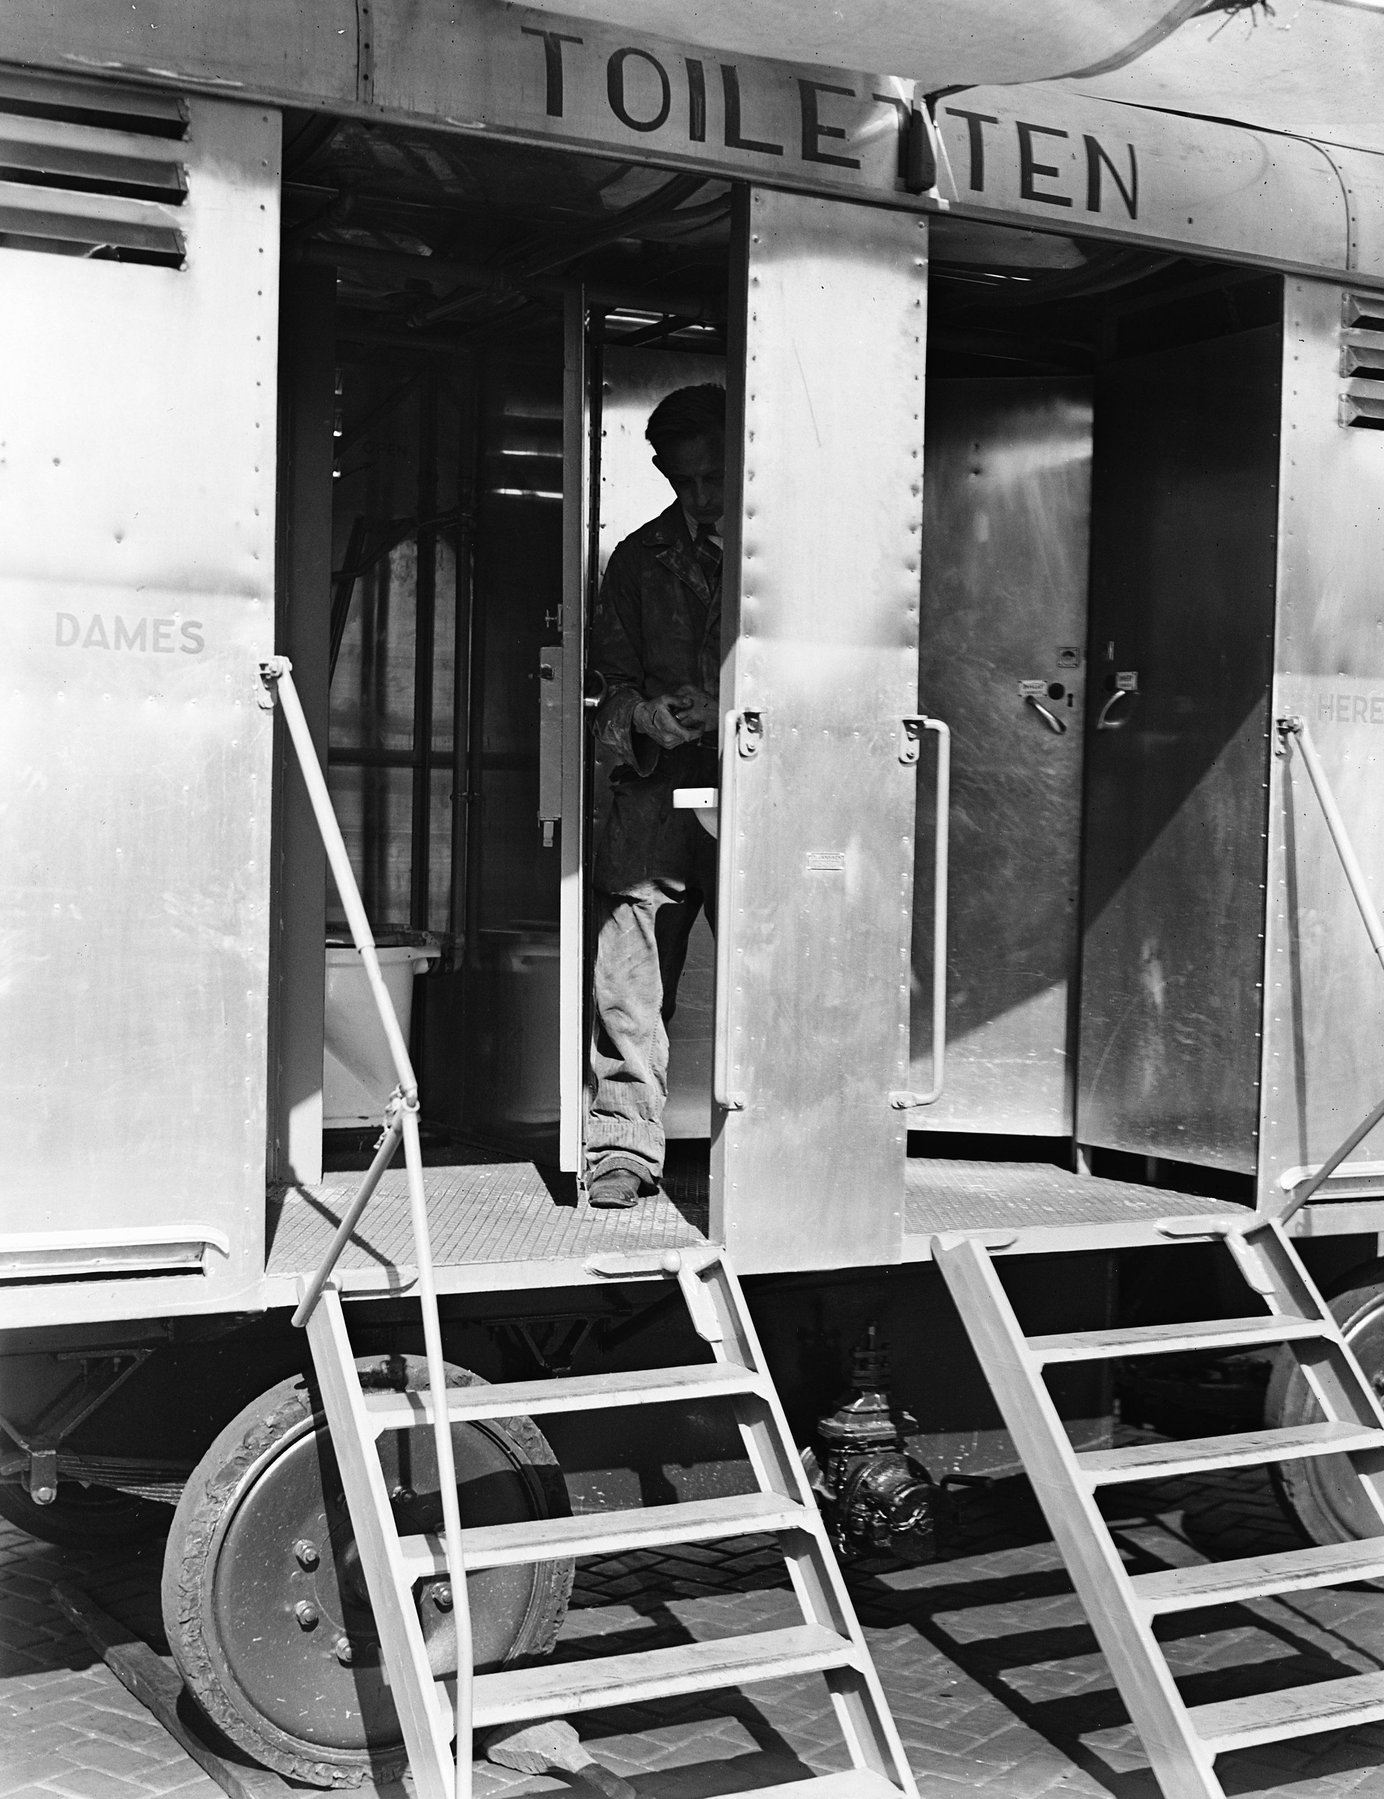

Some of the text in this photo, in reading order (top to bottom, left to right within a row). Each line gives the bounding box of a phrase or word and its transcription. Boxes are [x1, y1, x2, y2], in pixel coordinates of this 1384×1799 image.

[520, 25, 1139, 220] TOILETTEN
[55, 612, 206, 655] DAMES
[1317, 693, 1384, 725] HERE
